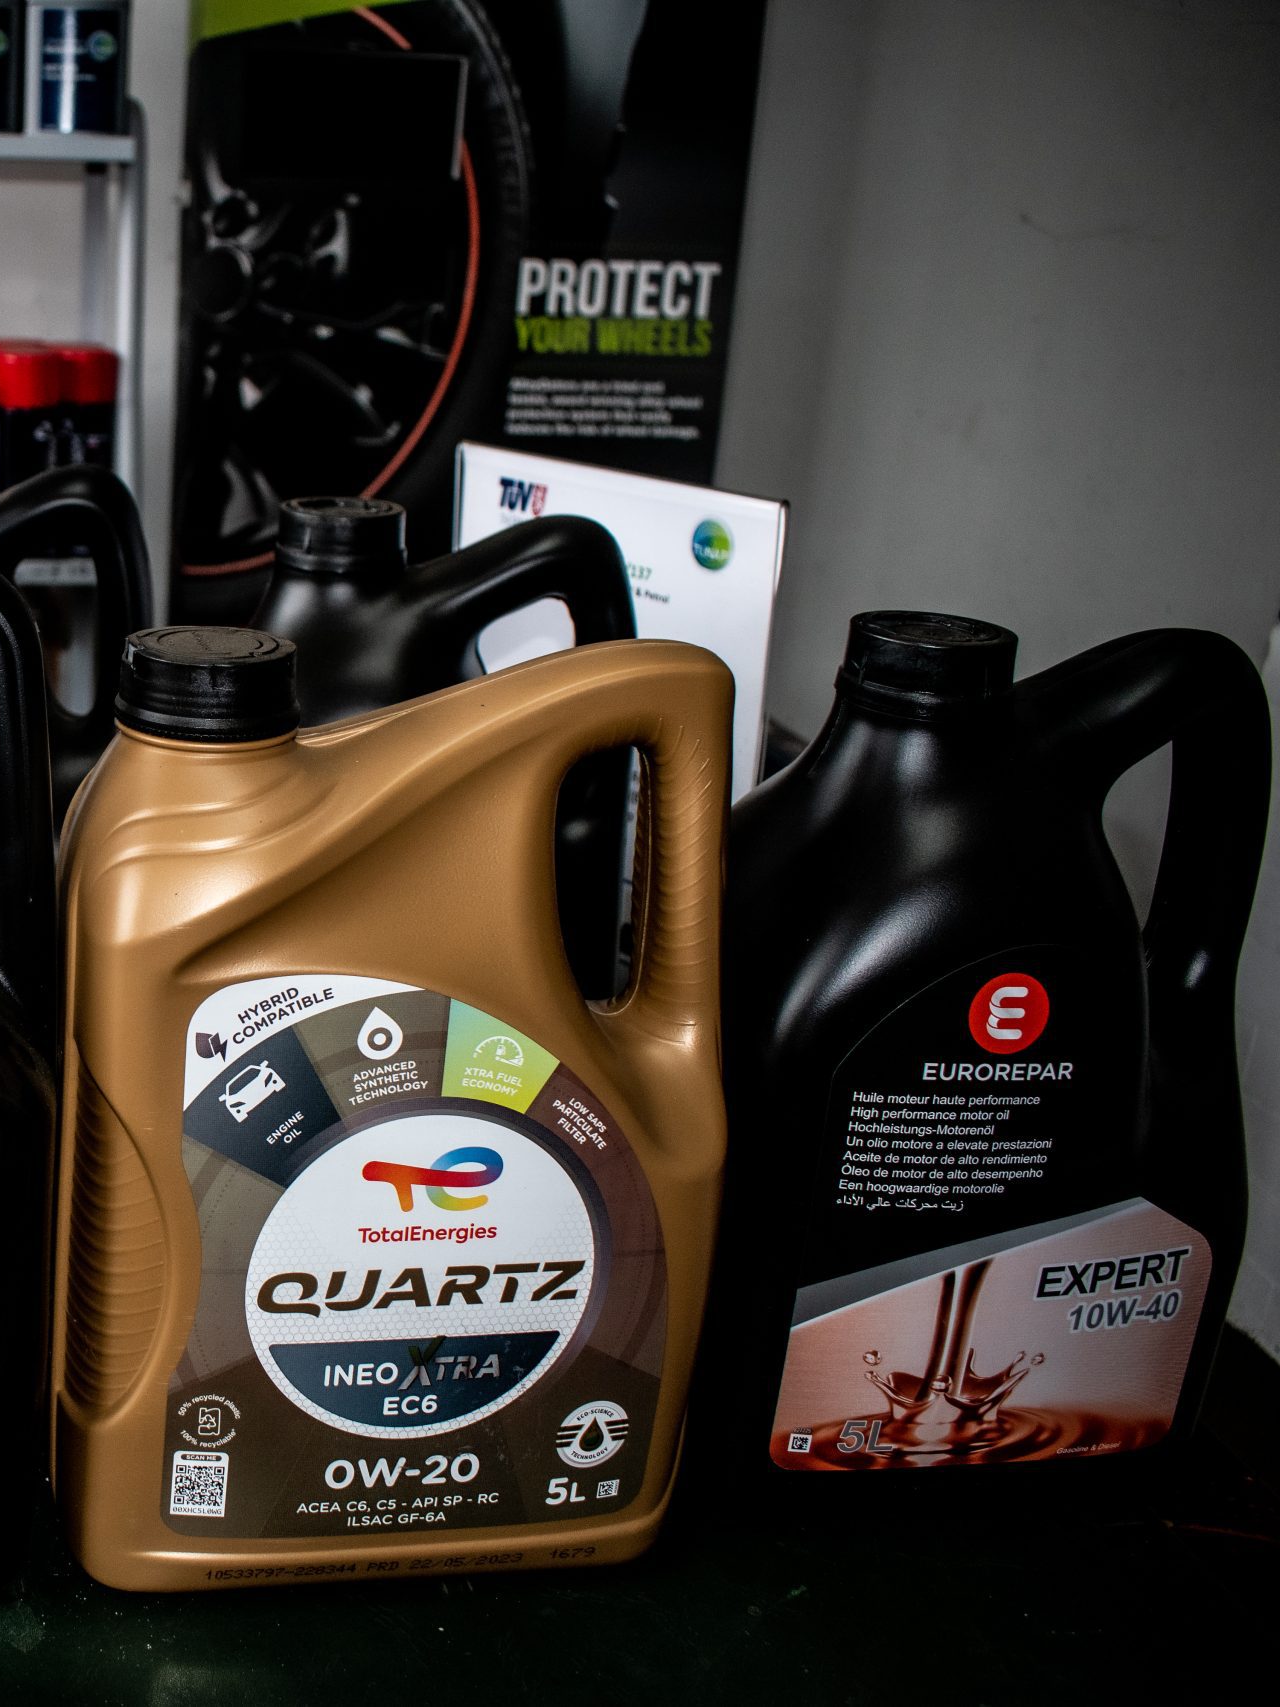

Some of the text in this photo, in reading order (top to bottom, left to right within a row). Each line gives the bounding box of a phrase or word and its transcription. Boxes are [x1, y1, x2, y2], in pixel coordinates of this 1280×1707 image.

[516, 257, 721, 320] PROTECT
[515, 316, 712, 356] YOUR WHEELS
[238, 987, 299, 1024] HYBRID
[232, 988, 334, 1045] COMPATIBLE
[353, 1061, 416, 1082] ADVANCED
[354, 1070, 418, 1092] SYNTHETIC
[464, 1067, 523, 1088] XTRA FUEL
[922, 1062, 1073, 1081] EUROREPAR
[349, 1080, 428, 1106] TECHNOLOGY
[462, 1078, 518, 1097] ECONOMY
[853, 1091, 1040, 1107] Huile moteur haute performance
[568, 1097, 607, 1133] LOW SAPS
[850, 1106, 1009, 1121] High performance motor oil
[266, 1111, 305, 1145] ENGINE
[552, 1100, 606, 1150] PARTICULATE
[557, 1117, 586, 1144] FILTER
[848, 1121, 994, 1136] Hochleistungs-Motorenöl
[283, 1129, 302, 1144] OIL
[846, 1136, 1052, 1151] Un olio motore a elevate prestazioni
[843, 1151, 1047, 1164] Aceite de motor de alto rendimiento
[839, 1179, 1005, 1195] Een hoogwaardige motorolie
[358, 1223, 497, 1244] TotalEnergies
[1036, 1247, 1191, 1299] EXPERT
[257, 1260, 586, 1318] QUARTZ
[1068, 1291, 1181, 1332] 10W-40
[324, 1363, 398, 1387] INEO
[192, 1394, 225, 1404] recycled
[223, 1400, 241, 1420] plastic
[383, 1395, 438, 1416] EC6
[180, 1430, 198, 1445] 100%
[836, 1419, 895, 1455] 5L
[571, 1447, 608, 1459] TECHNOLOGY
[324, 1453, 480, 1490] 0W-20
[545, 1478, 586, 1505] 5L
[297, 1493, 499, 1513] ACEA C6, C5 API SP RC
[347, 1512, 446, 1527] ILSAC GF-6A
[366, 1560, 400, 1572] PRD
[409, 1553, 523, 1570] 22/05/2023
